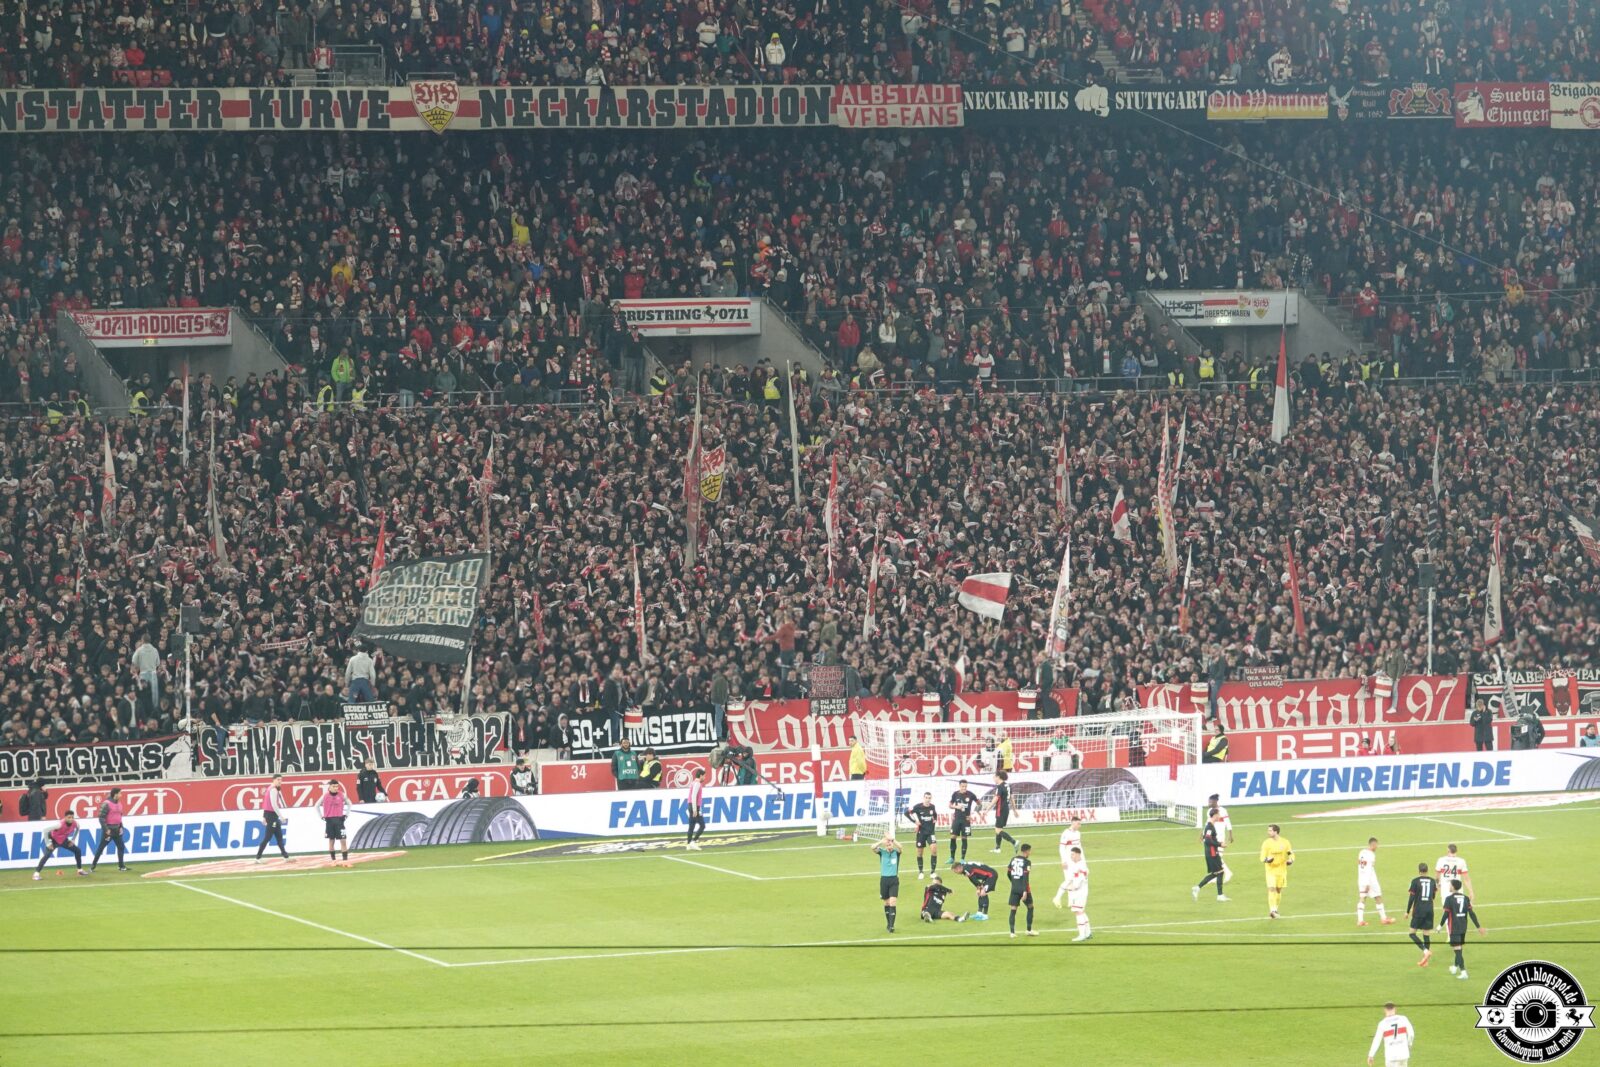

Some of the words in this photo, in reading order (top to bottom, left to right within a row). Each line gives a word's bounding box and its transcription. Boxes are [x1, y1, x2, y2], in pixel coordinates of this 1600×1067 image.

[841, 85, 961, 104] ALBSTADT
[964, 90, 1069, 111] NECKAR-FILS
[1115, 90, 1207, 111] STUTTGART
[1208, 90, 1241, 113] Old
[1244, 88, 1328, 113] Warriors
[1489, 87, 1545, 104] Suebia
[249, 89, 391, 130] KURVE
[479, 87, 831, 128] NECKARSTADION
[844, 105, 959, 126] VFB-FANS
[1486, 107, 1549, 125] Ehingen
[719, 308, 748, 320] 0711
[1205, 309, 1251, 318] OBERSCHWABEN
[101, 317, 133, 335] 0711
[138, 315, 204, 334] ADDICTS
[368, 704, 387, 712] ALLE
[1406, 679, 1458, 722] 97
[469, 716, 502, 764] 02
[570, 765, 587, 780] 34
[1230, 760, 1513, 799] FALKENREIFEN.DE
[1032, 808, 1097, 823] WINAMAX
[1011, 858, 1024, 877] 36
[1443, 864, 1458, 879] 24
[1421, 882, 1431, 898] 11
[1456, 897, 1465, 913] 7
[1390, 1023, 1398, 1040] 7
